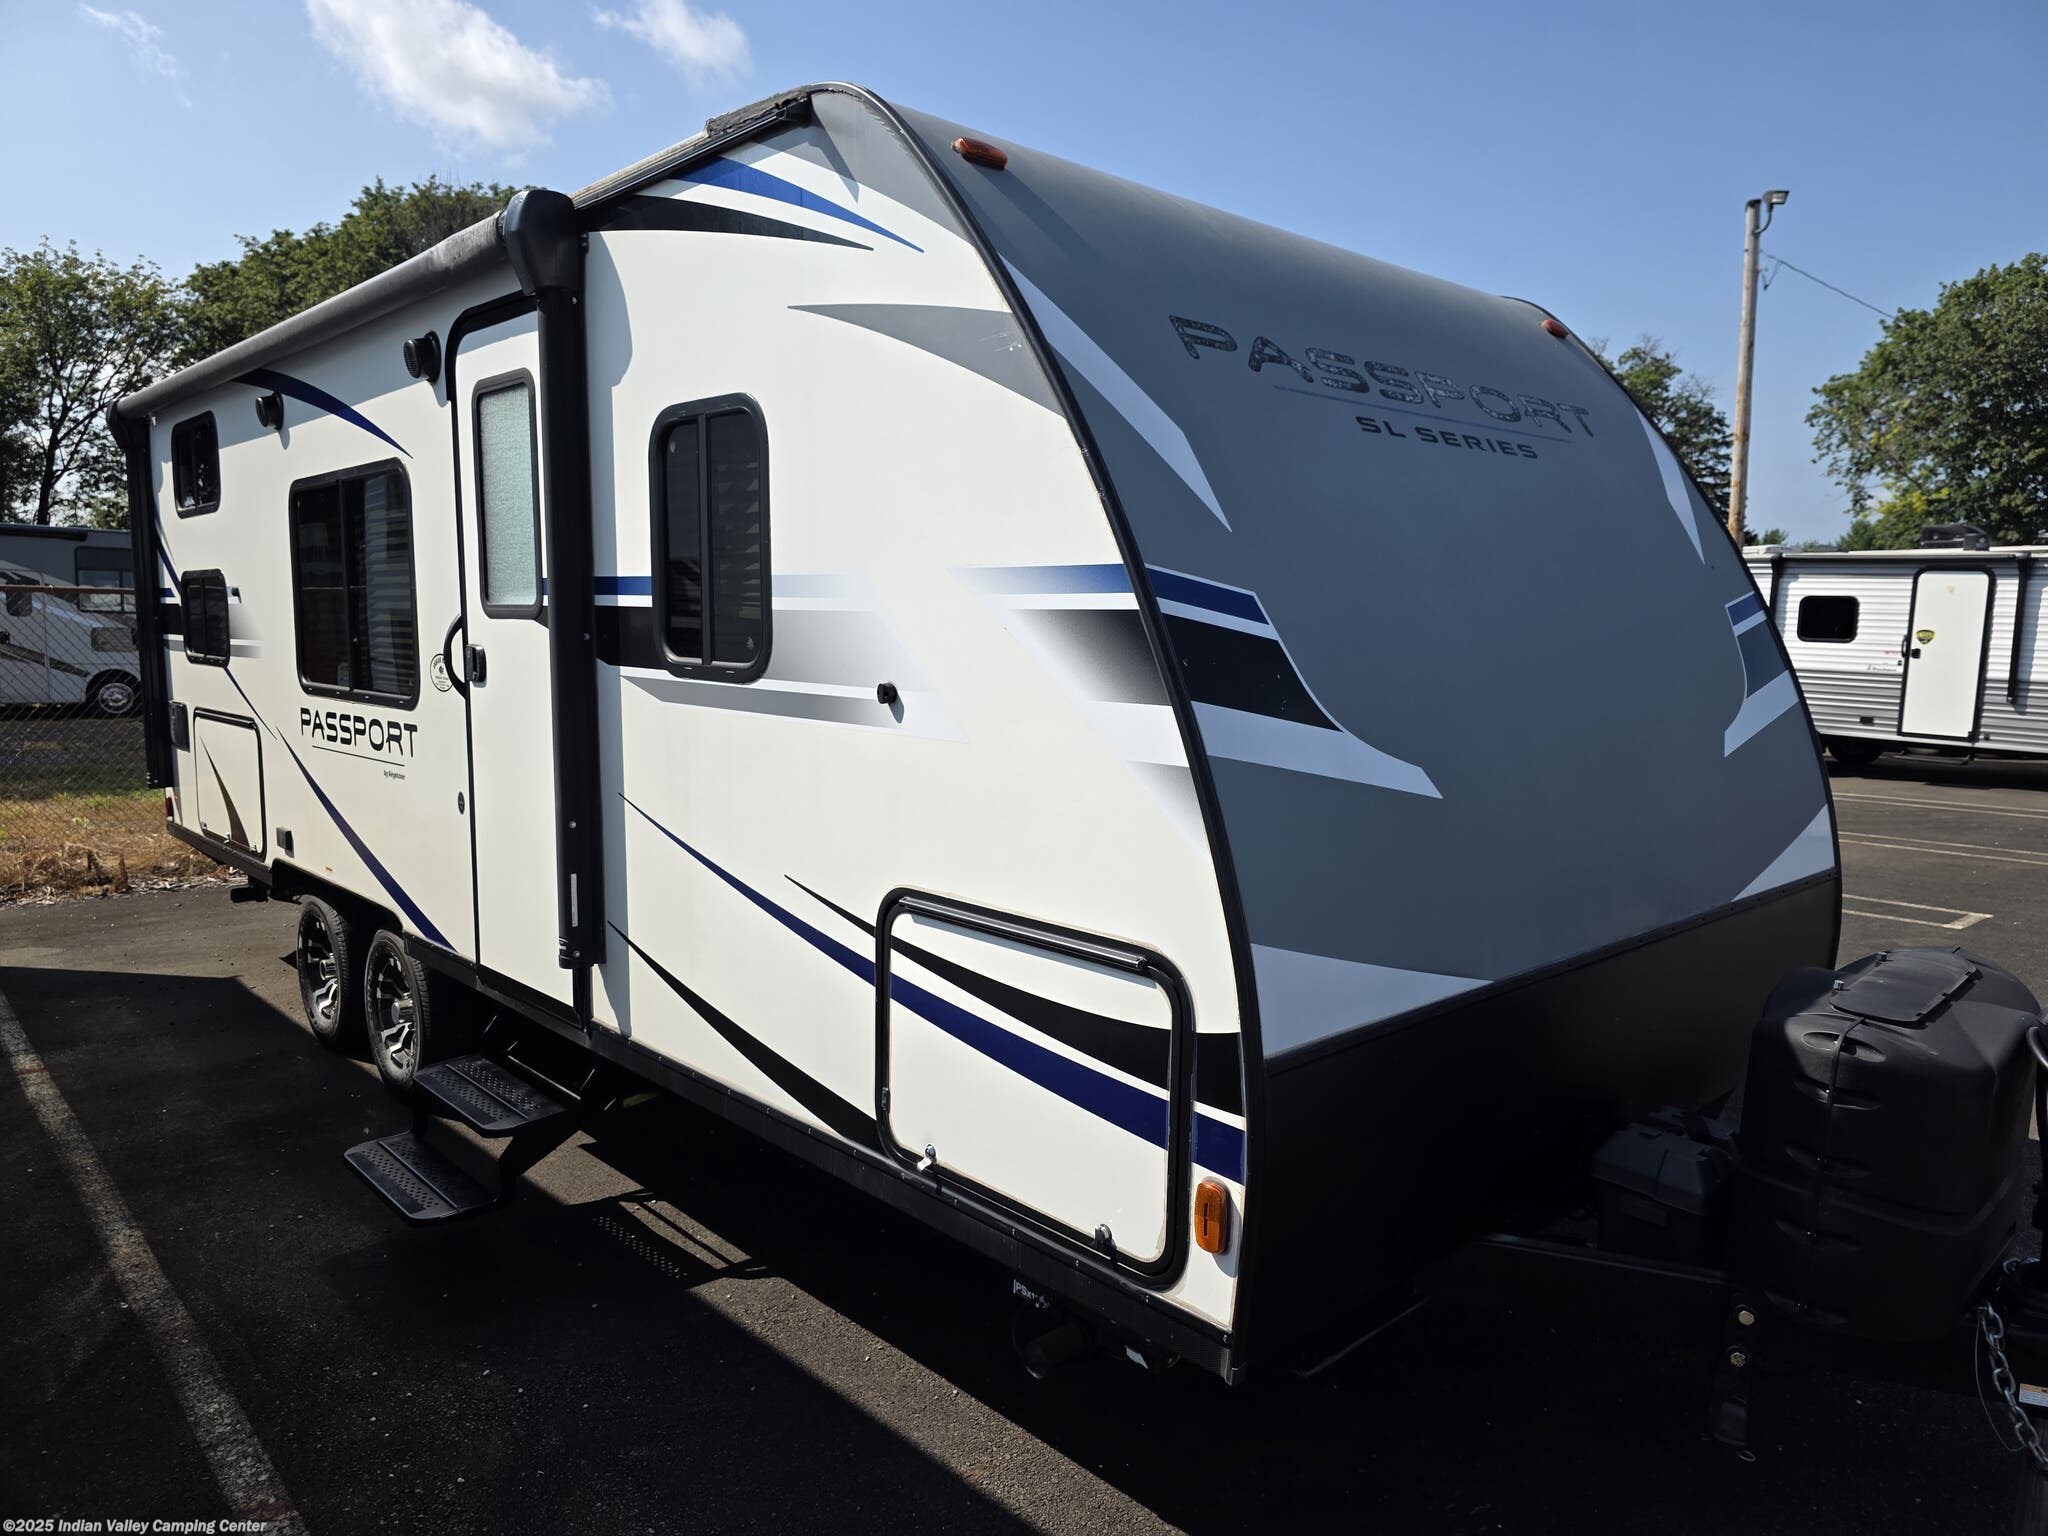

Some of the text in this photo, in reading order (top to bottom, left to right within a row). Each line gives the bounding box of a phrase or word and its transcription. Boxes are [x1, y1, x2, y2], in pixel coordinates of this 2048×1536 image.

[1169, 315, 1594, 438] PASSPORT
[1355, 416, 1538, 459] SL SERIES
[301, 707, 418, 758] PASSPORT
